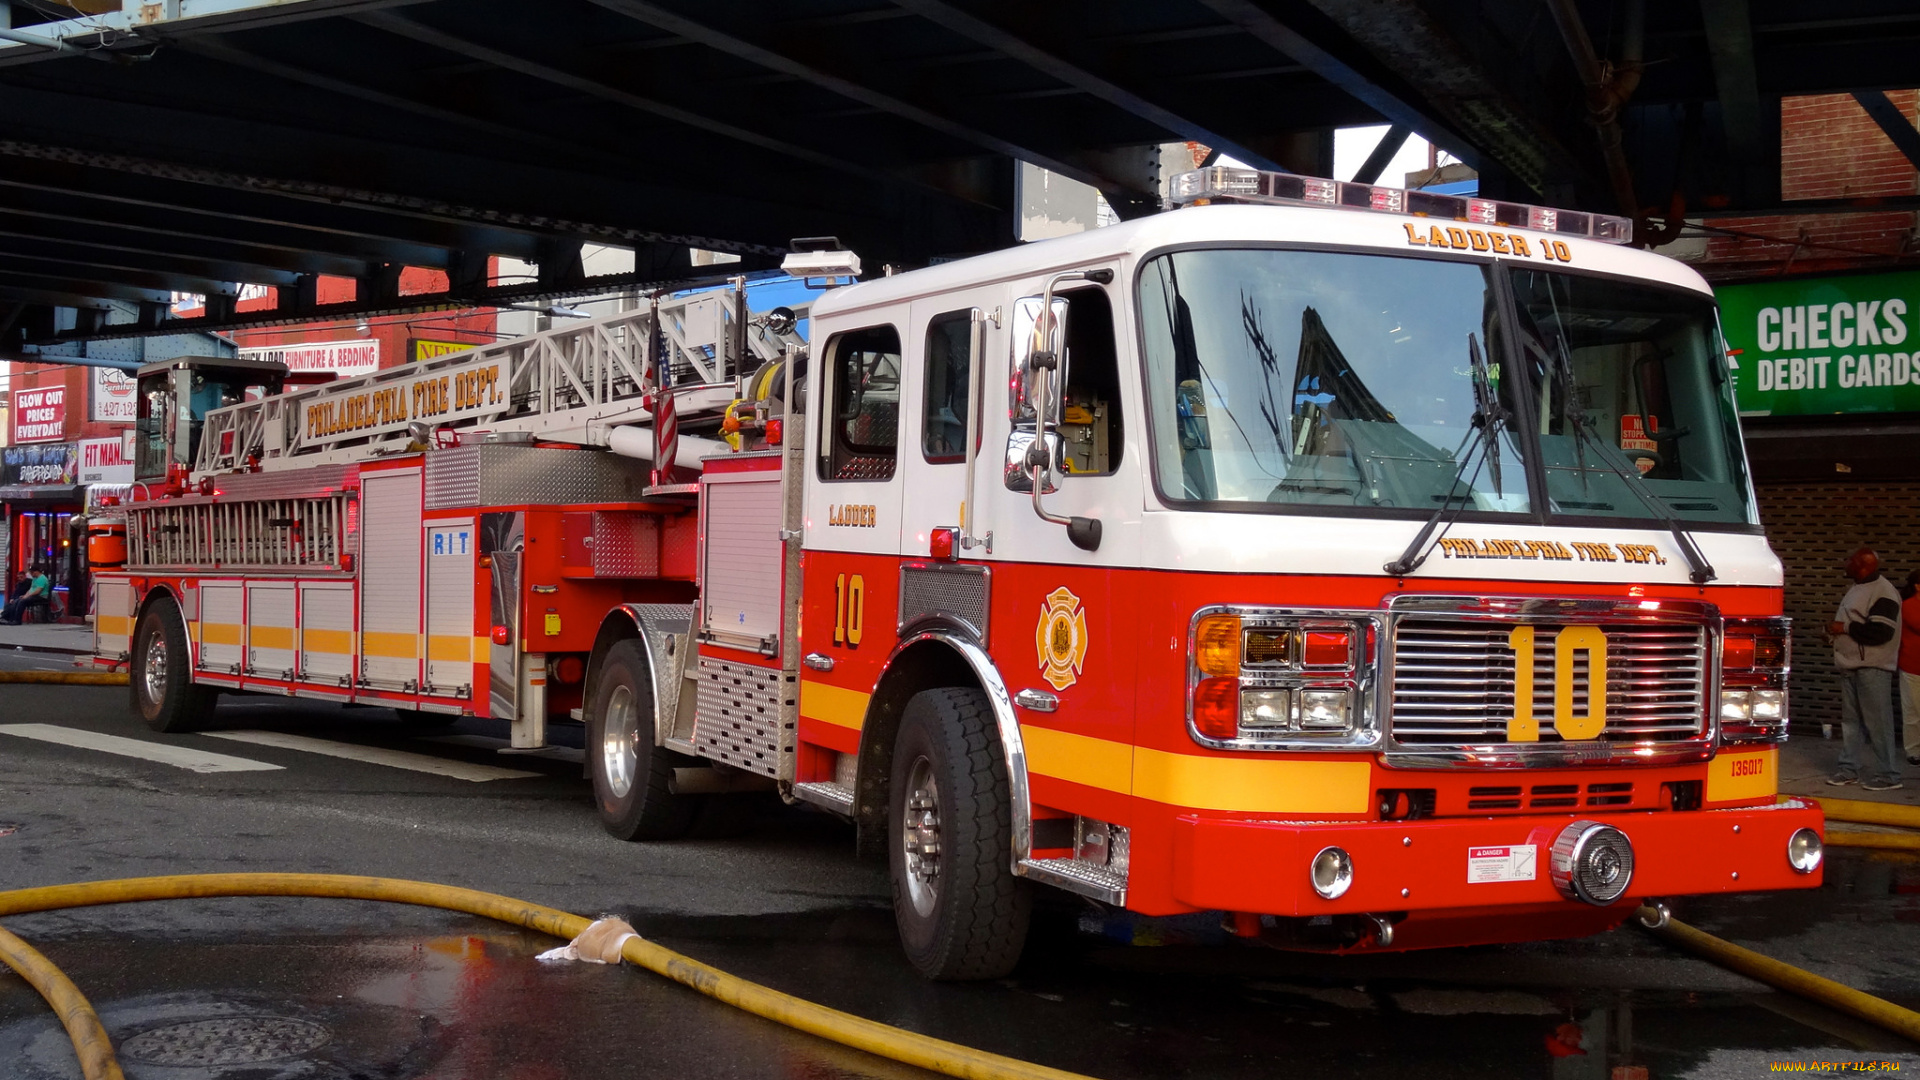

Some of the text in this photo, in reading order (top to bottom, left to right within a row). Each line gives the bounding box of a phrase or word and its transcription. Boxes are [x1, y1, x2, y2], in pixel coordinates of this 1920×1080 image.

[1403, 223, 1572, 262] LADDER 10
[1757, 298, 1908, 352] CHECKS
[285, 349, 326, 370] FURNITURE
[328, 349, 335, 368] &
[337, 346, 375, 367] BEDDING
[1758, 356, 1831, 391] DEBIT
[1838, 351, 1920, 388] CARDS
[19, 390, 64, 408] BLOW OUT
[307, 365, 504, 440] PHILADELPHIA FIRE DEPT.
[26, 407, 55, 422] PRICES
[18, 421, 62, 438] EVERYDAY!
[1623, 430, 1647, 438] STOPP
[85, 444, 98, 467] FIT
[1623, 441, 1655, 450] ANY TIME
[829, 504, 877, 528] LADDER
[435, 532, 468, 554] RIT
[1439, 537, 1668, 565] PHILADELPHIA FIRE DEPT.
[833, 572, 864, 649] 10
[1507, 626, 1608, 742] 10
[1731, 758, 1764, 777] 136017
